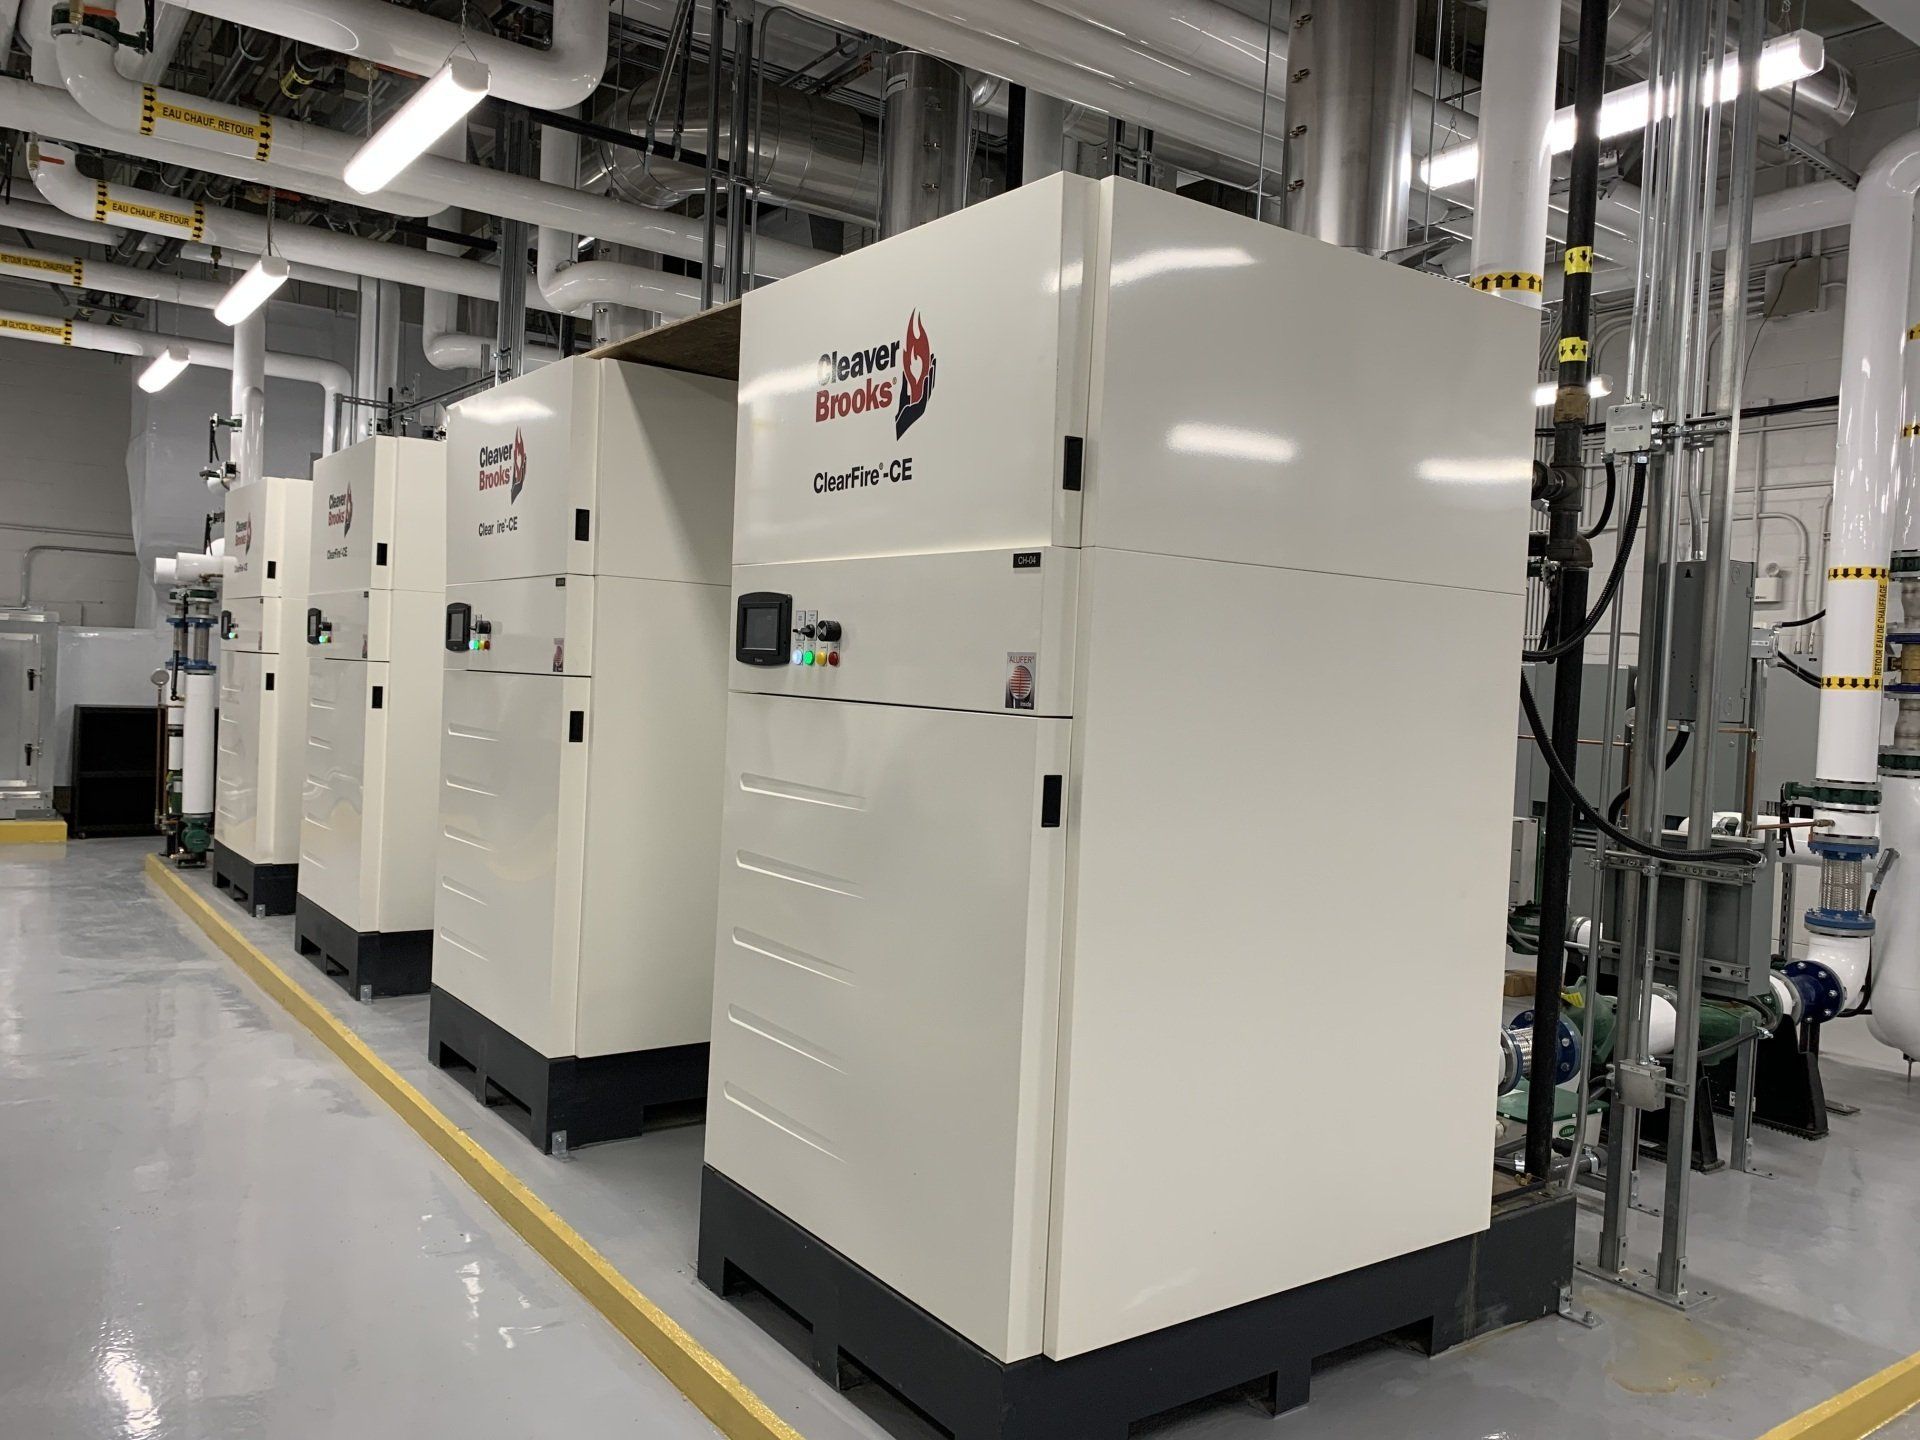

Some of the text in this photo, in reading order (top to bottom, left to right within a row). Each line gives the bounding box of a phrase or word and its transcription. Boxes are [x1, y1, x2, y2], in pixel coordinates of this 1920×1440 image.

[162, 106, 182, 119] EAU
[218, 120, 254, 137] RETOUR
[112, 203, 128, 213] EAU
[159, 212, 189, 226] RETOUR
[9, 321, 29, 331] GLYCOL
[31, 324, 62, 336] CHAUFFAGE
[817, 340, 900, 386] Cleaver
[480, 443, 513, 468] Cleaver
[478, 516, 518, 537] Clearire-CE
[1018, 555, 1037, 565] CH-04
[1874, 584, 1887, 676] RETOUR EAU DE CHAUFFAGE
